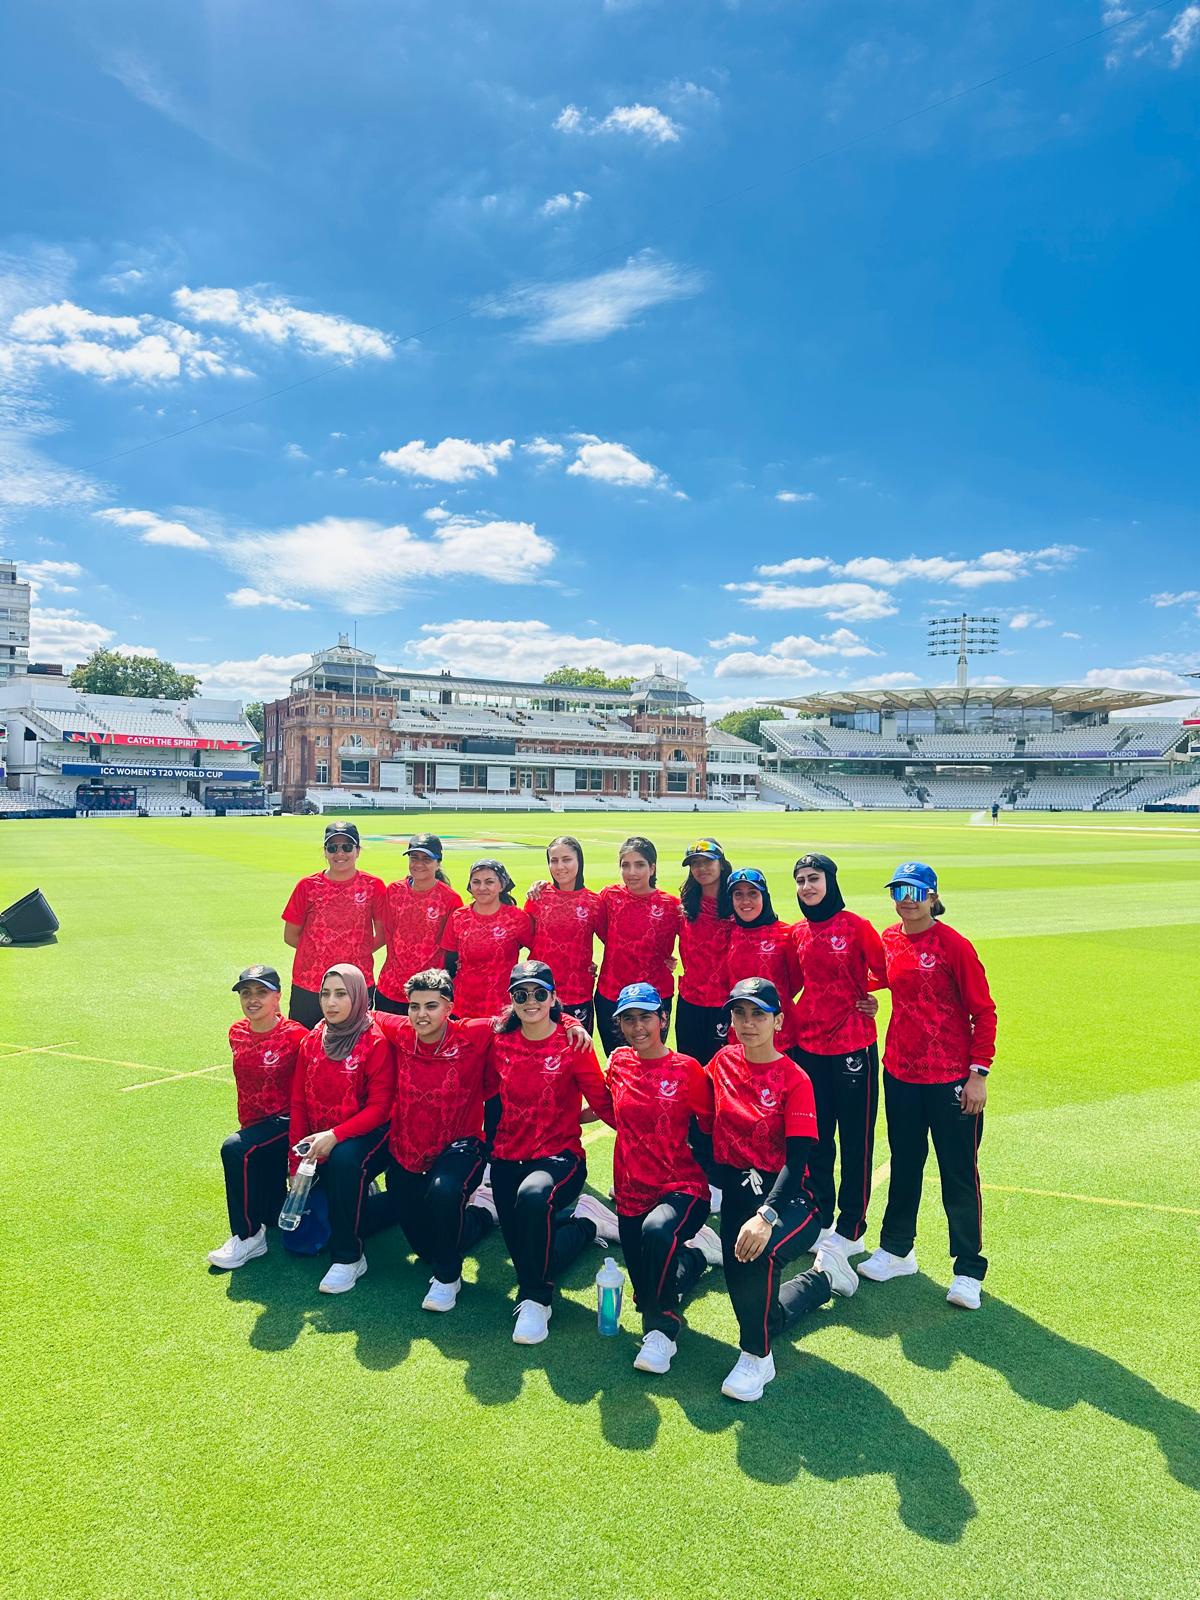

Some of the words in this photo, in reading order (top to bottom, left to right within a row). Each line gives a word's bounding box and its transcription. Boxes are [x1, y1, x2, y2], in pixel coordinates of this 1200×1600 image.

[127, 736, 154, 745] CATCH
[173, 739, 198, 747] SPIRIT
[116, 768, 156, 776] WOMEN'S
